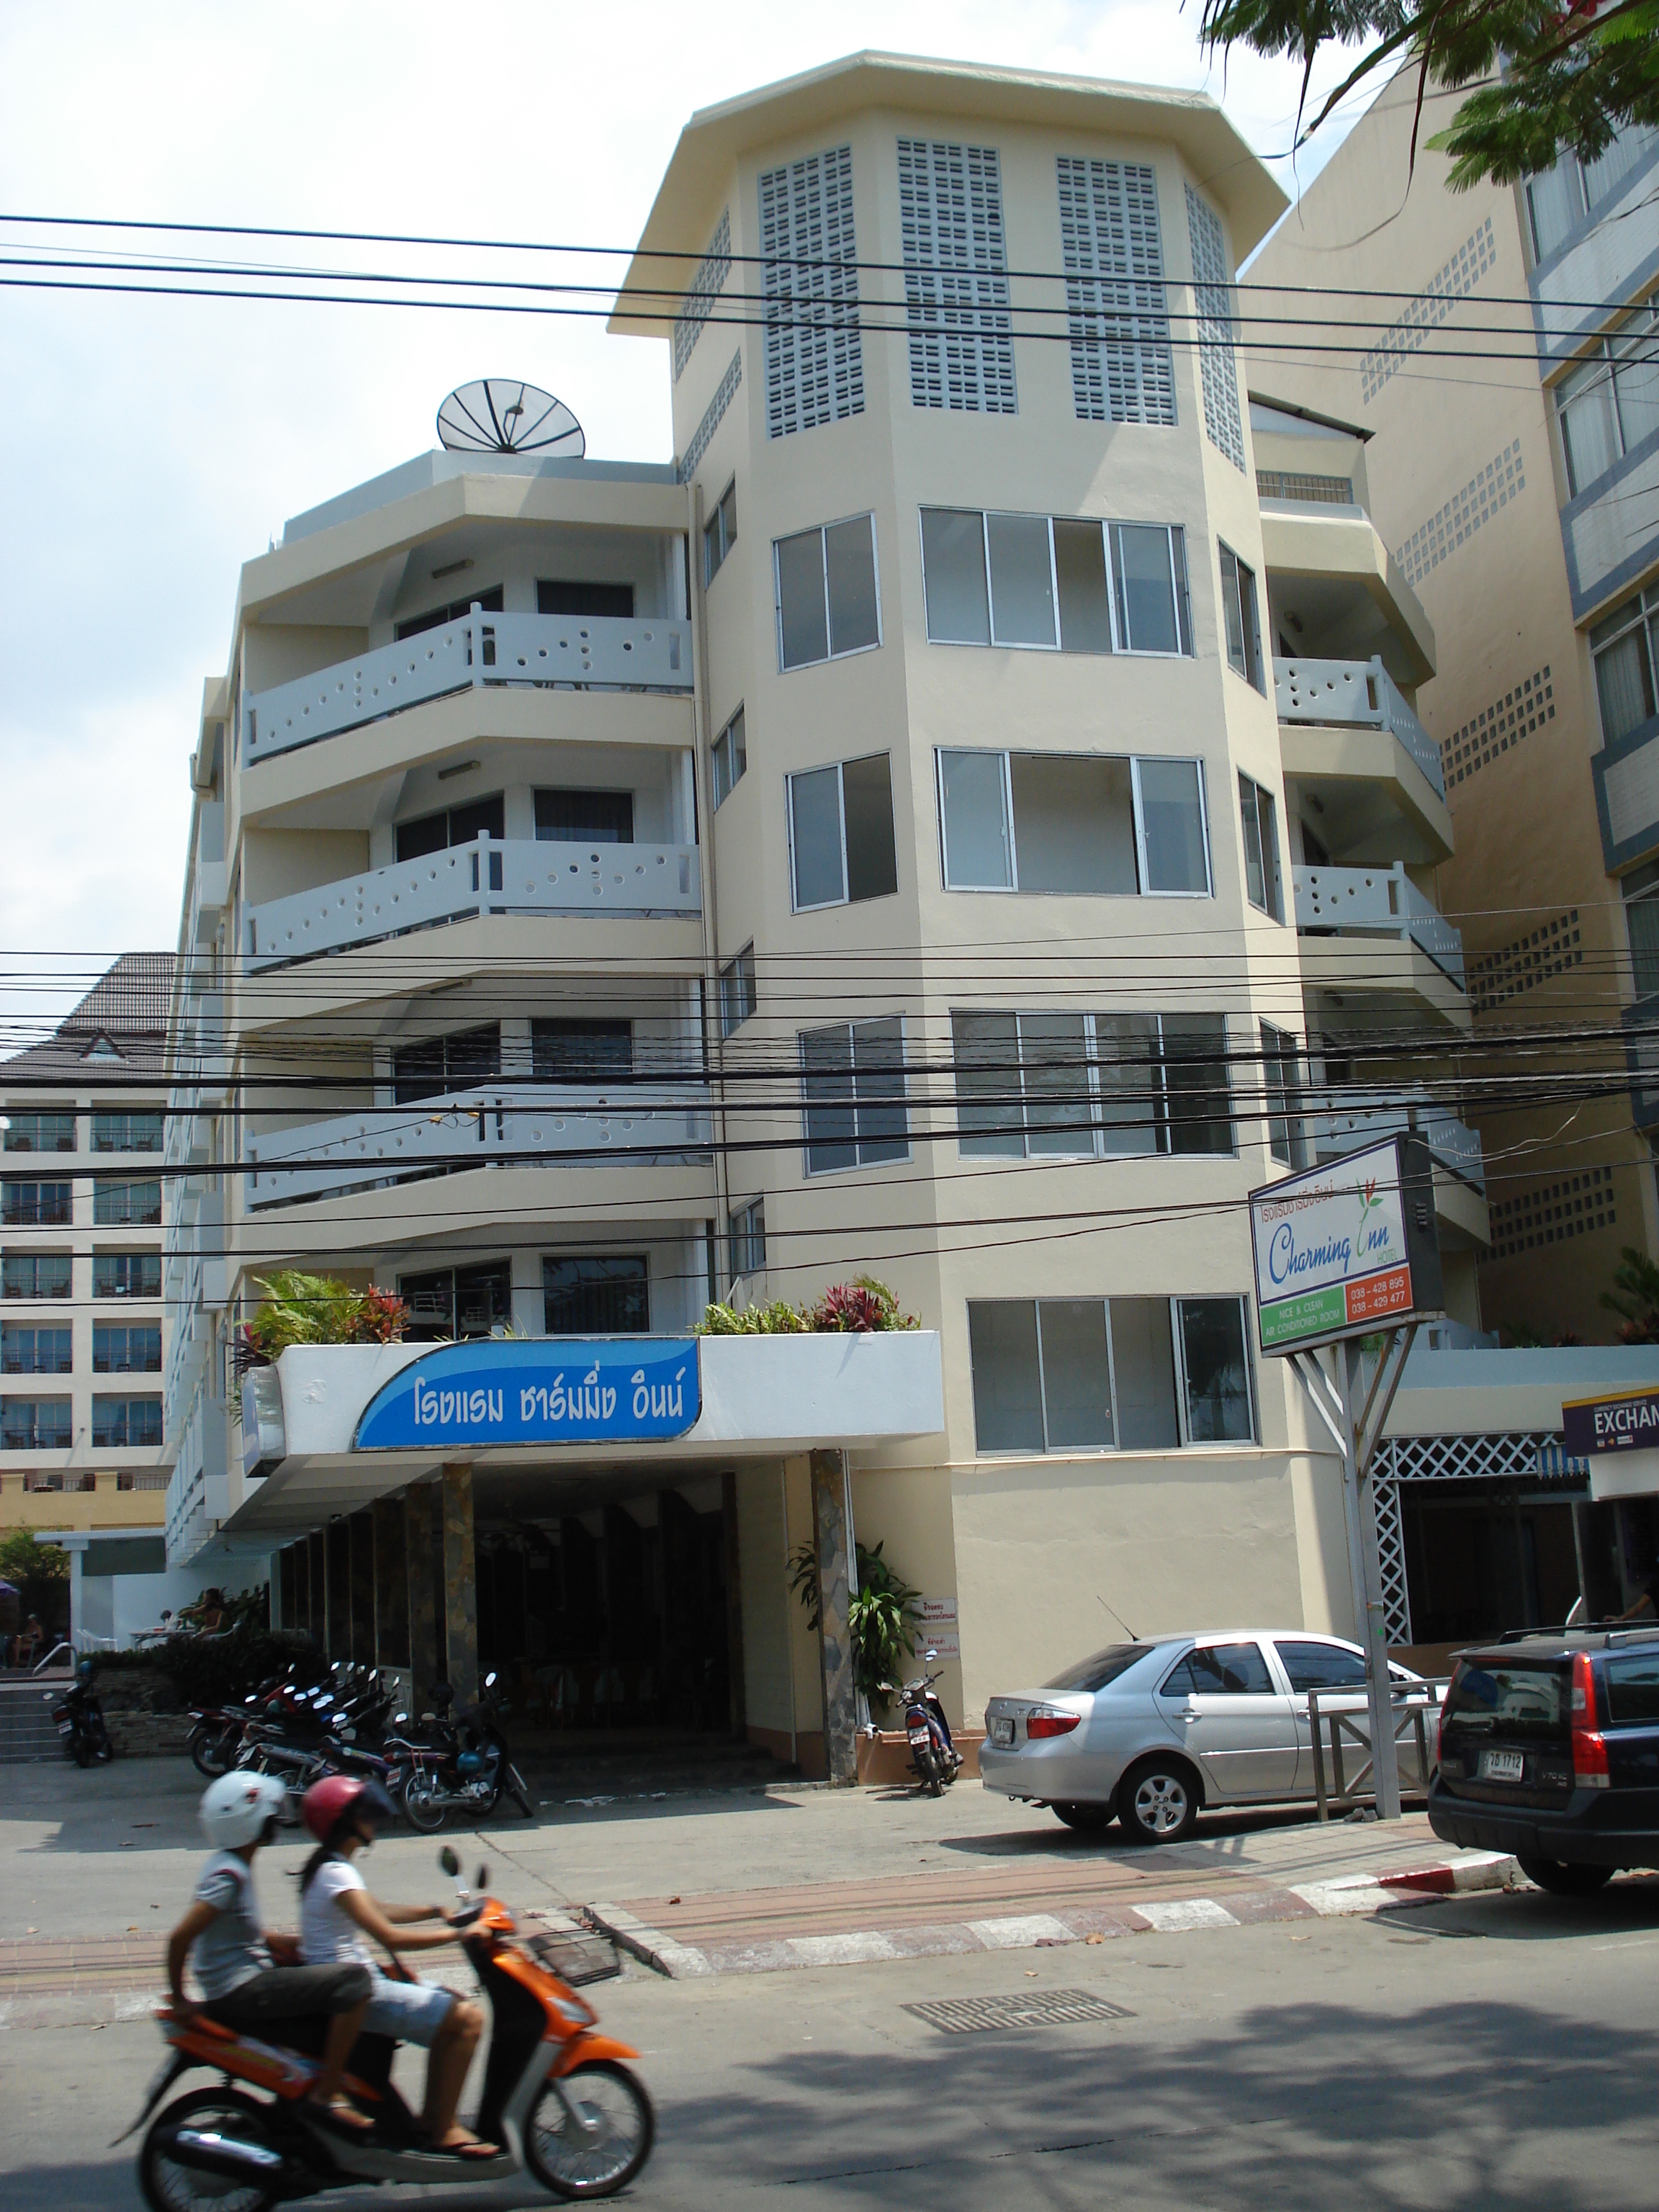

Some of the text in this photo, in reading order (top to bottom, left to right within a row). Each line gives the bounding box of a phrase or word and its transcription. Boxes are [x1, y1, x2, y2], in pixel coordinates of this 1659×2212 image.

[1269, 1223, 1351, 1284] Charming
[1377, 1248, 1398, 1264] HOTEL
[1351, 1288, 1365, 1300] 038
[1372, 1282, 1388, 1294] 428
[1389, 1276, 1404, 1289] 895
[1279, 1308, 1293, 1319] NICE
[1304, 1299, 1323, 1313] CLEAN
[1352, 1301, 1367, 1315] 038
[1373, 1295, 1388, 1308] 429
[1390, 1291, 1405, 1303] 477
[1266, 1308, 1340, 1337] AIR CONDITIONED ROOM
[413, 1360, 687, 1425] โรงแรม ชาร์มมิ่ง อินน์
[1503, 1753, 1521, 1768] 1712
